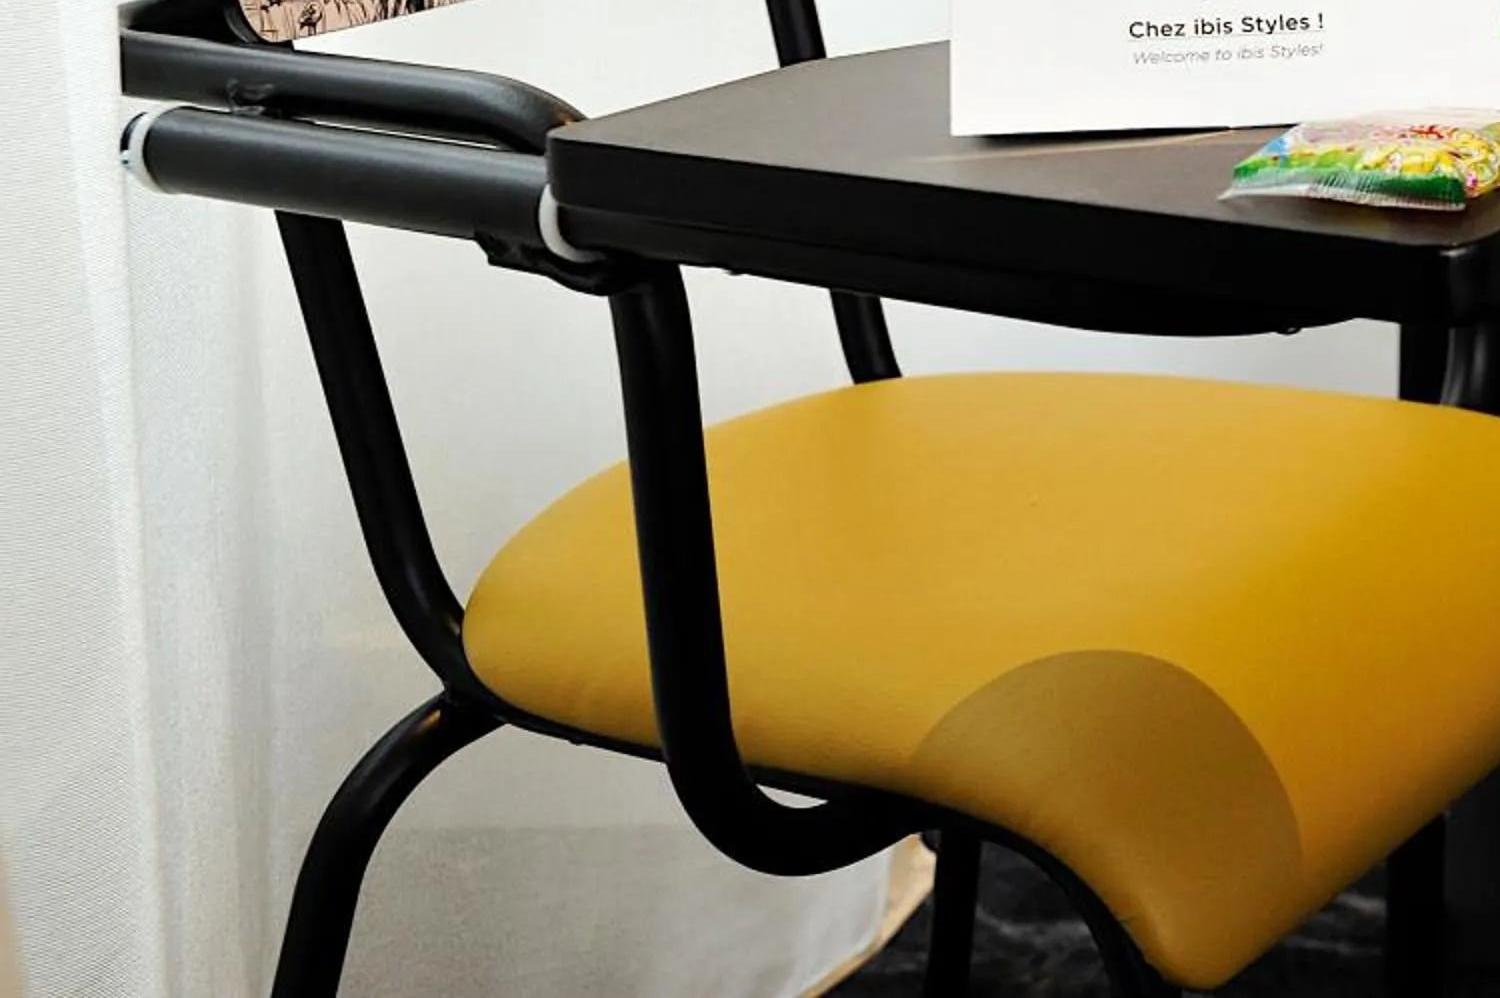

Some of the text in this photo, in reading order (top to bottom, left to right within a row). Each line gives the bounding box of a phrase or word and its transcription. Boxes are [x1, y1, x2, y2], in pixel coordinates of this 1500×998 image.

[1129, 21, 1186, 38] Chez
[1194, 17, 1233, 35] ibis
[1241, 14, 1311, 35] Styles
[1132, 50, 1210, 65] Welcome
[1215, 49, 1233, 61] to
[1237, 47, 1265, 60] ibis
